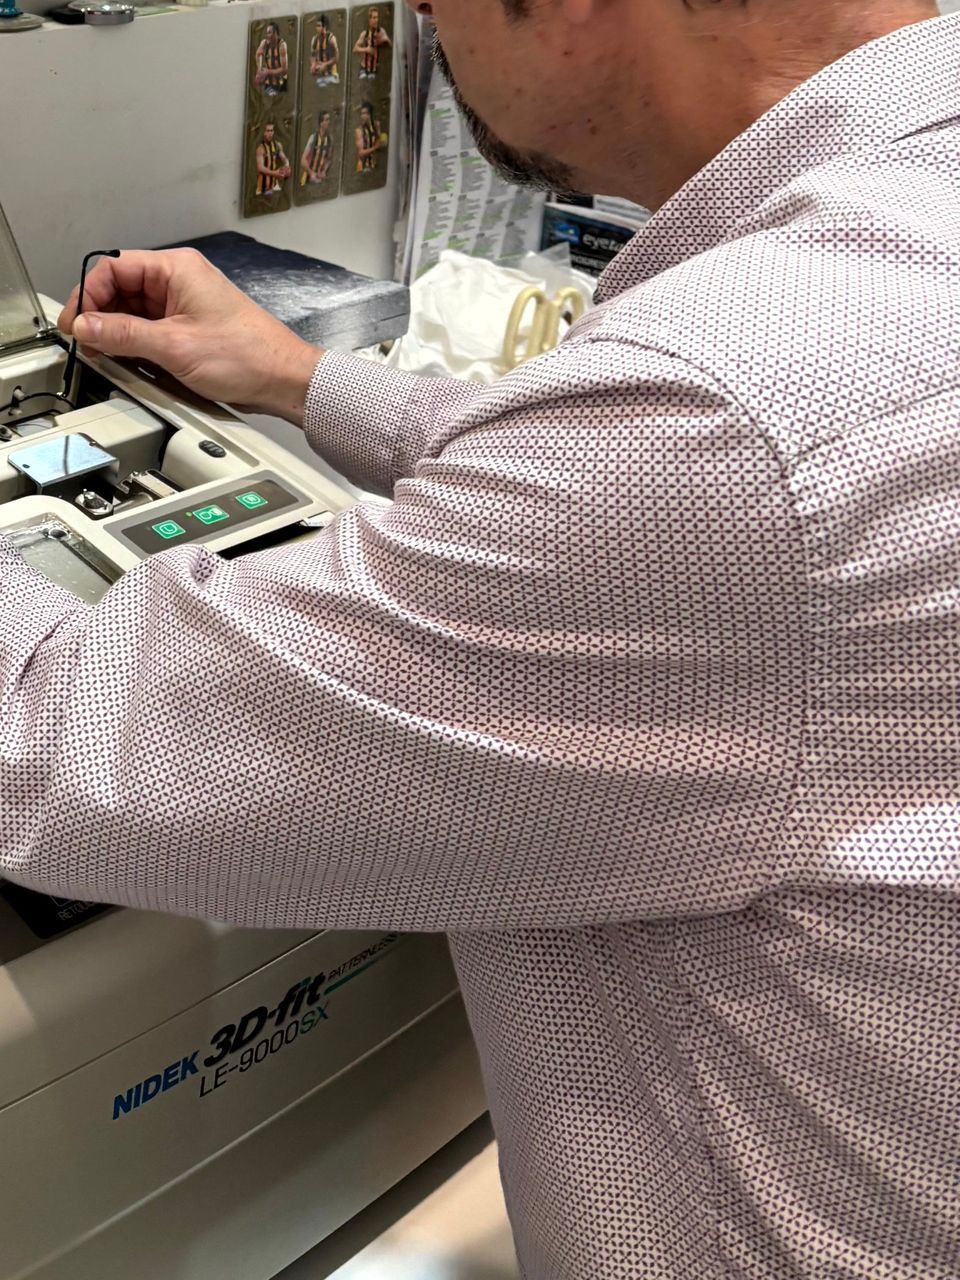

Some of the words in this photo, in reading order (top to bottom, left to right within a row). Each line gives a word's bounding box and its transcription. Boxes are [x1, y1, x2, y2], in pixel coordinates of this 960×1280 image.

[112, 1051, 200, 1120] NIDEK
[203, 971, 326, 1069] 3D-fit
[199, 1001, 330, 1098] LE-9000SX
